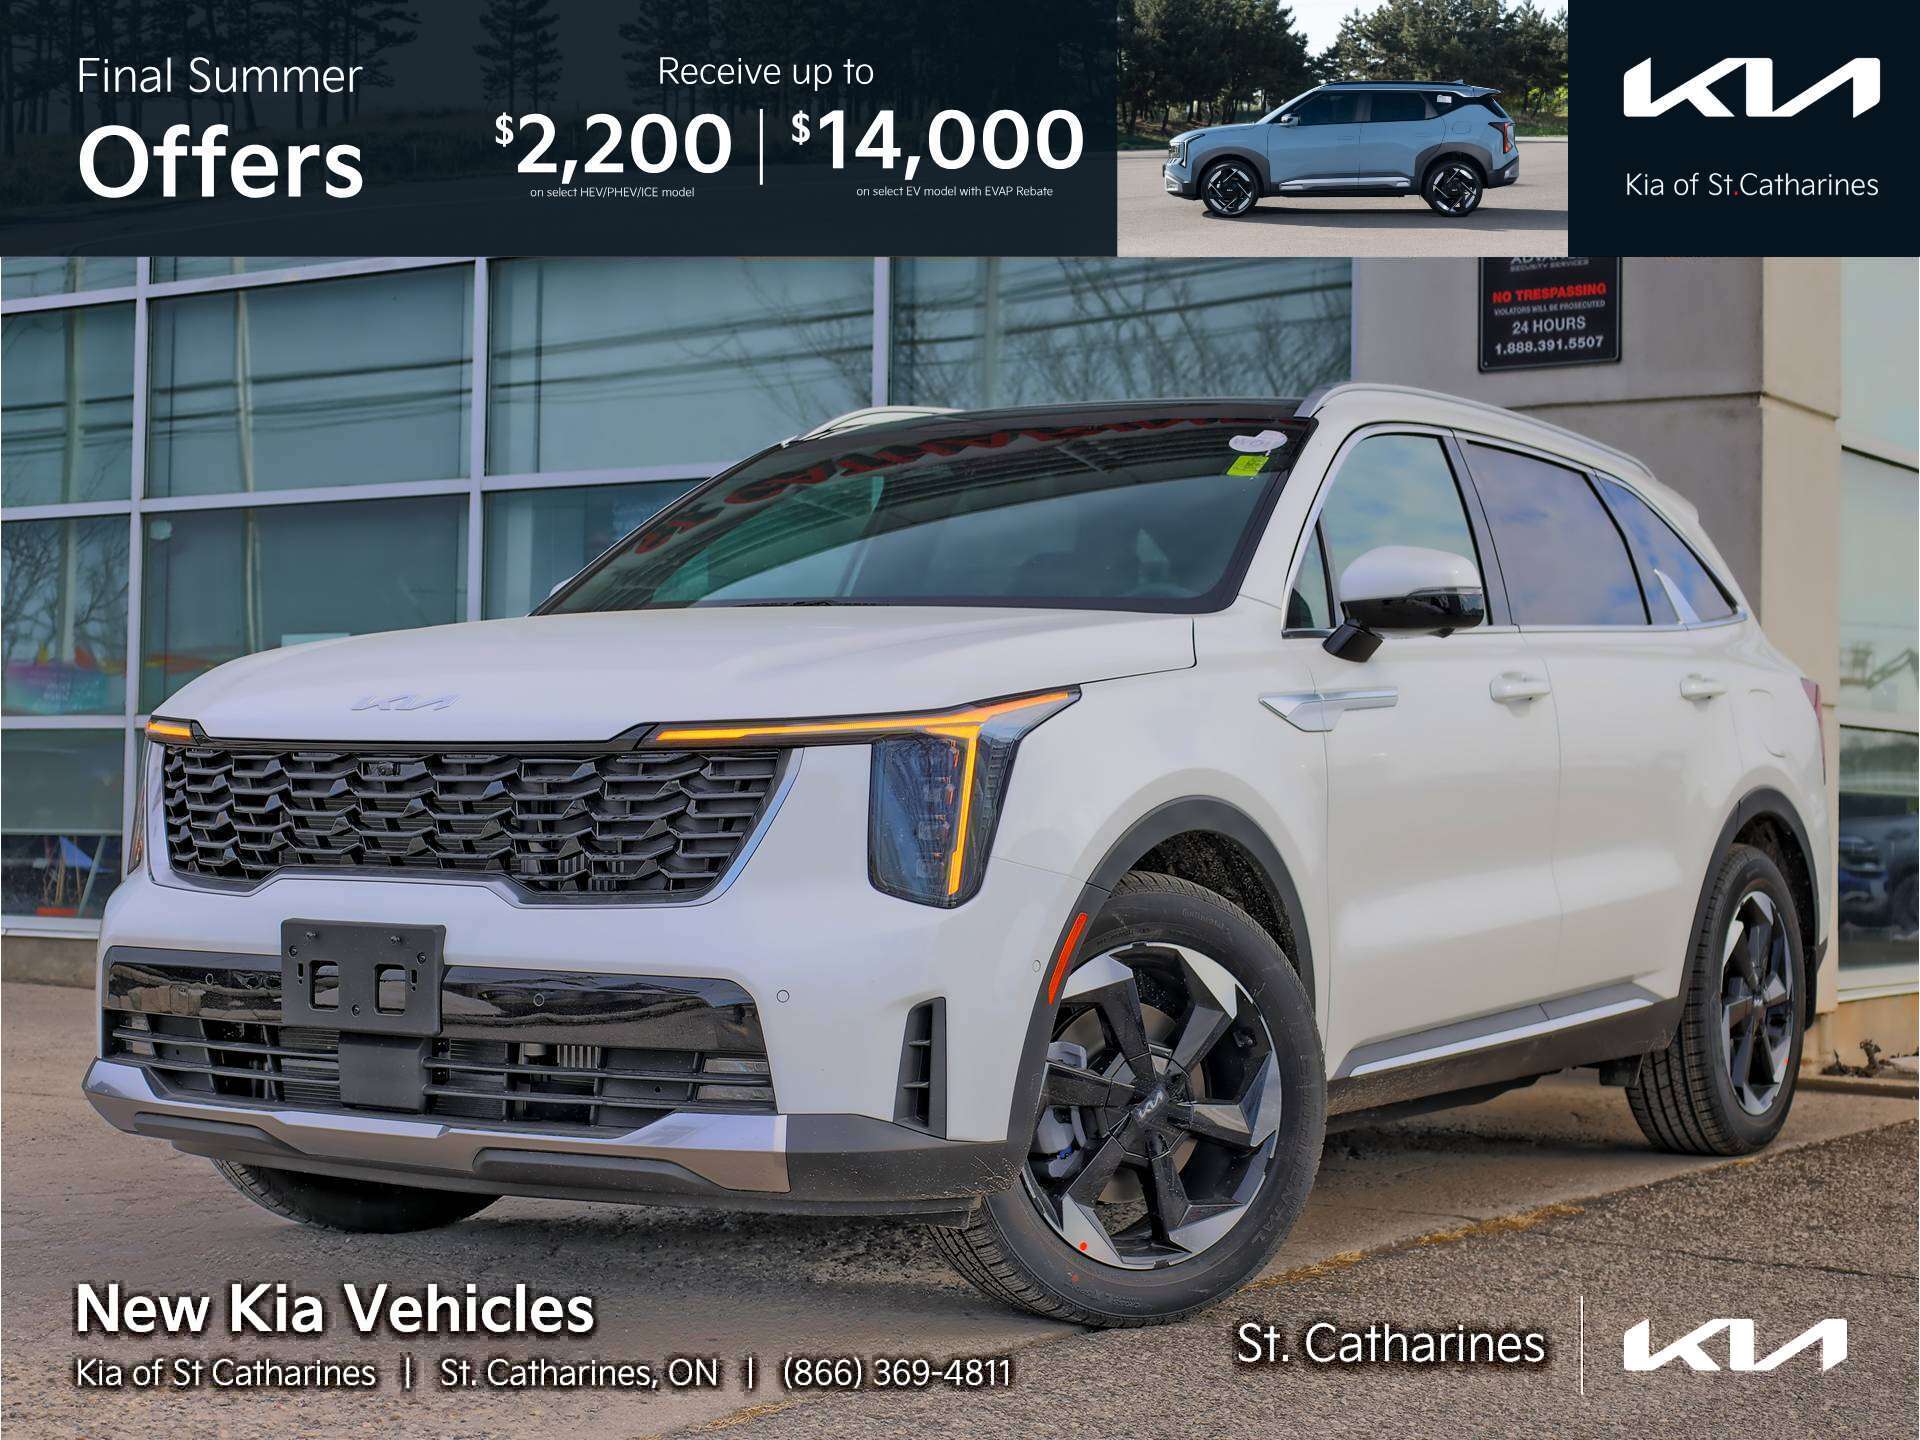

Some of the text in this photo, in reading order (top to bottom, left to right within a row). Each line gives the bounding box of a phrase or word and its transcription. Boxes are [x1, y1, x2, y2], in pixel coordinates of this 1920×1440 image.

[1493, 282, 1606, 303] NO TRESPASSING
[1494, 299, 1606, 316] VIOLATORS WILL BE PROSECUTED
[1512, 315, 1587, 335] 24 HOURS
[1495, 335, 1604, 355] 1.888.391.5507
